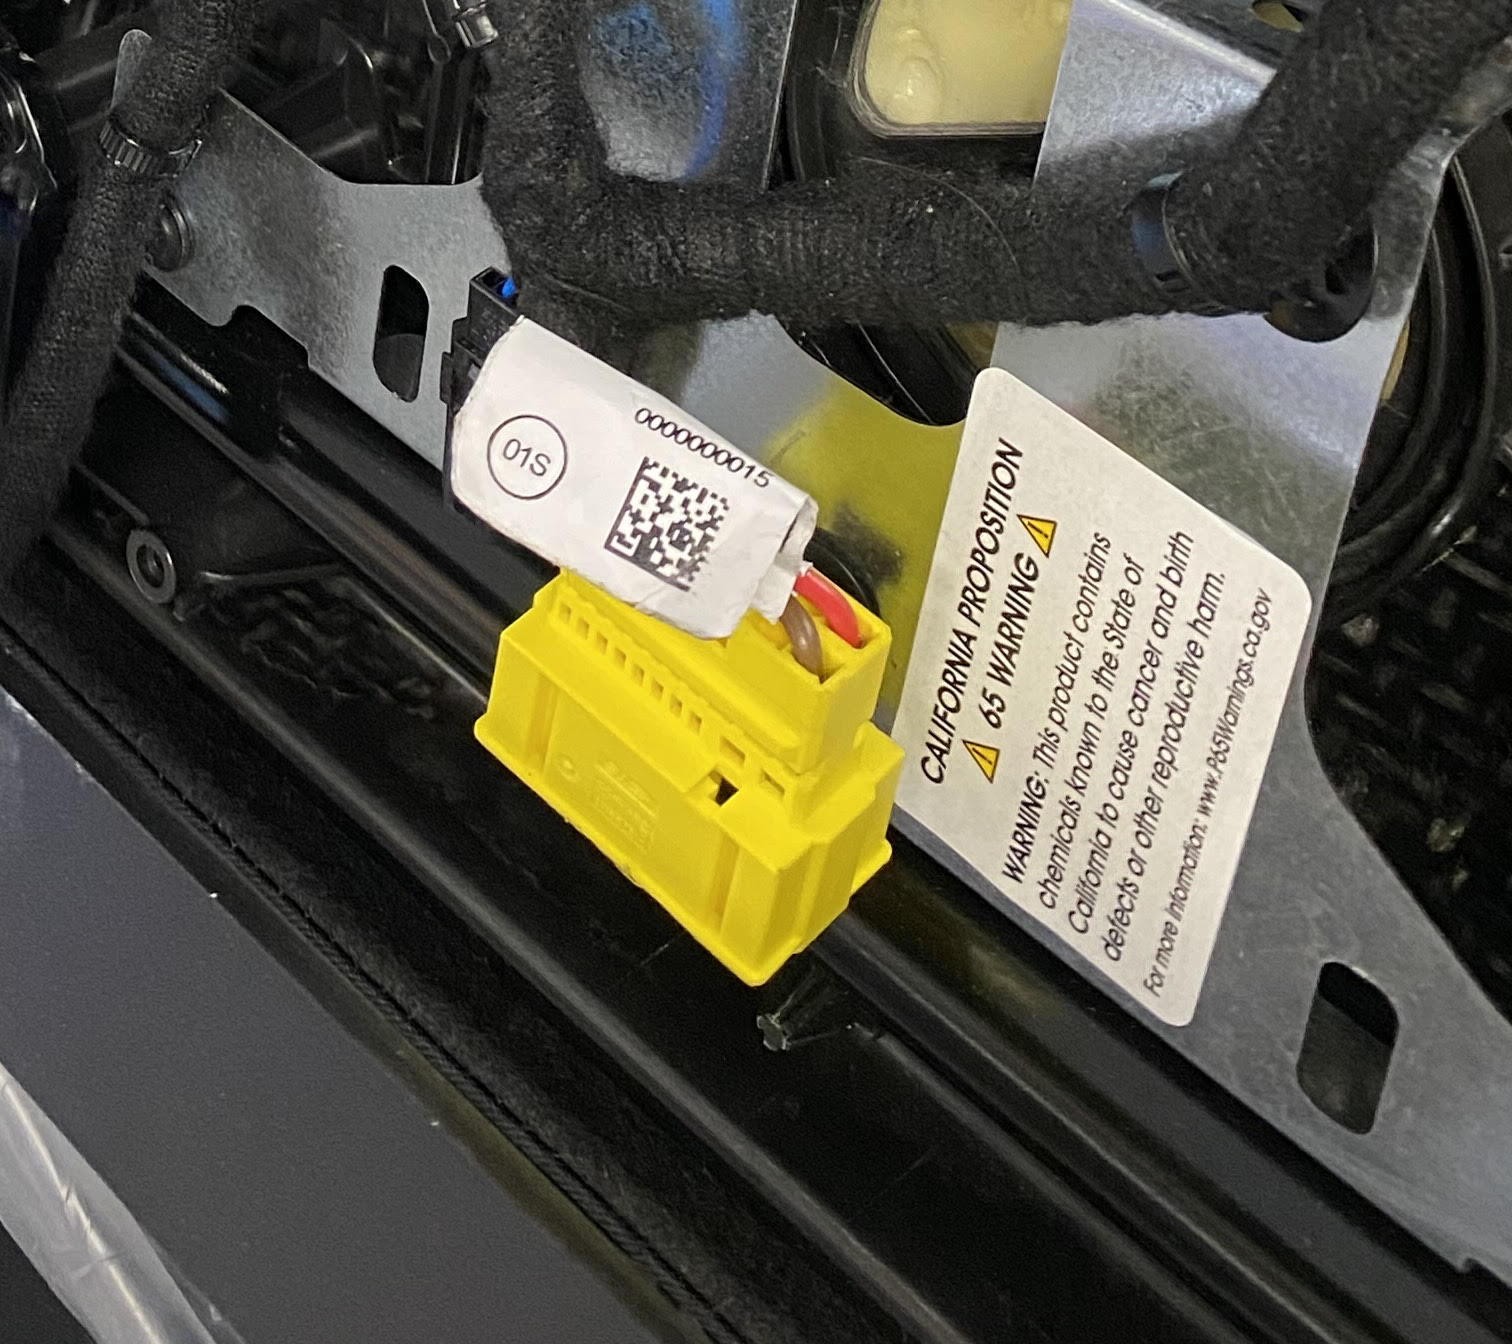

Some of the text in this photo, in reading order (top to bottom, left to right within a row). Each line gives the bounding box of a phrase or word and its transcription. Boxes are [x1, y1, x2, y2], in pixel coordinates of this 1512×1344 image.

[502, 438, 551, 476] 01S
[634, 407, 776, 488] 0000000015
[920, 437, 1023, 784] CALIFORNIA PROPOSITION
[979, 552, 1039, 729] 65 WARNING
[1001, 531, 1112, 884] WARNING: This product contains
[1037, 552, 1145, 909] chemicals known to the State of
[1068, 531, 1194, 934] California to cause cancer and birth
[1101, 572, 1226, 962] defects or other reproductive harm.
[1143, 965, 1166, 998] For
[1156, 920, 1179, 969] more
[1197, 587, 1272, 818] www.P65Warnings.ca.gov
